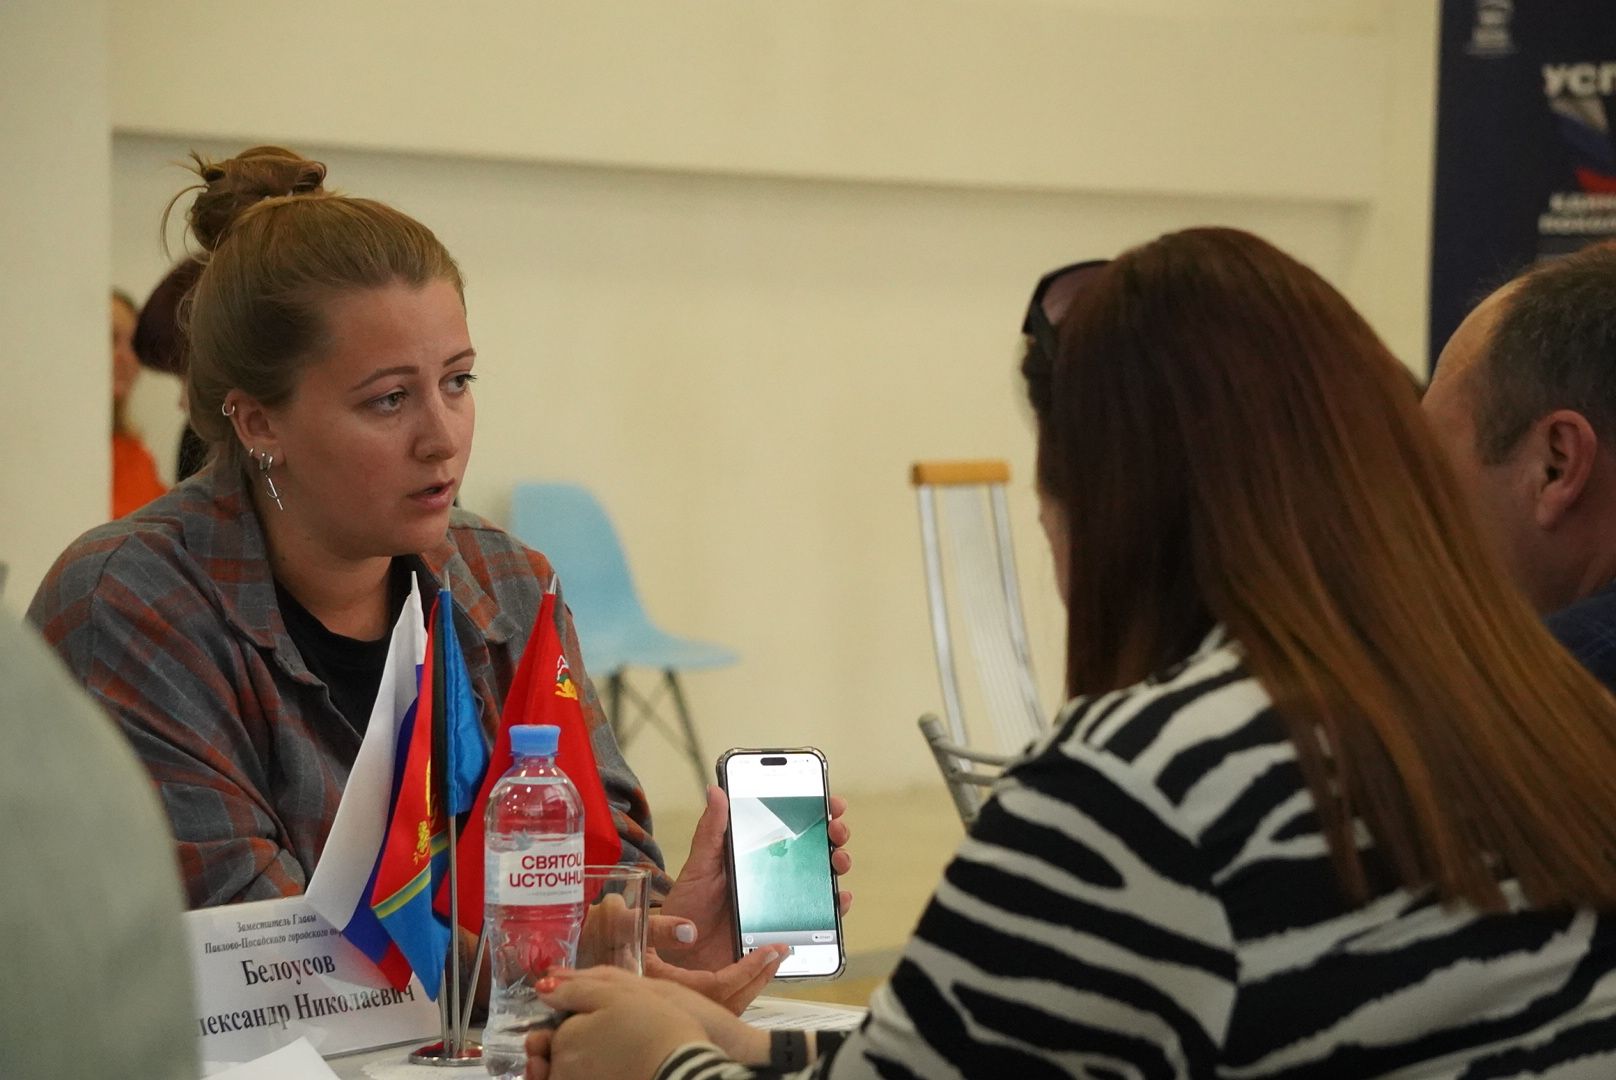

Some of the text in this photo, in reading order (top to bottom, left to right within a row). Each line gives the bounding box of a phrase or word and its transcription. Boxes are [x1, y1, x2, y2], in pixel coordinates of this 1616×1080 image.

[508, 871, 582, 888] ИСТОЧНИ
[237, 913, 317, 932] Заместитель Главы
[240, 954, 336, 987] Белоусов
[196, 983, 416, 1037] лександр Николаевич
